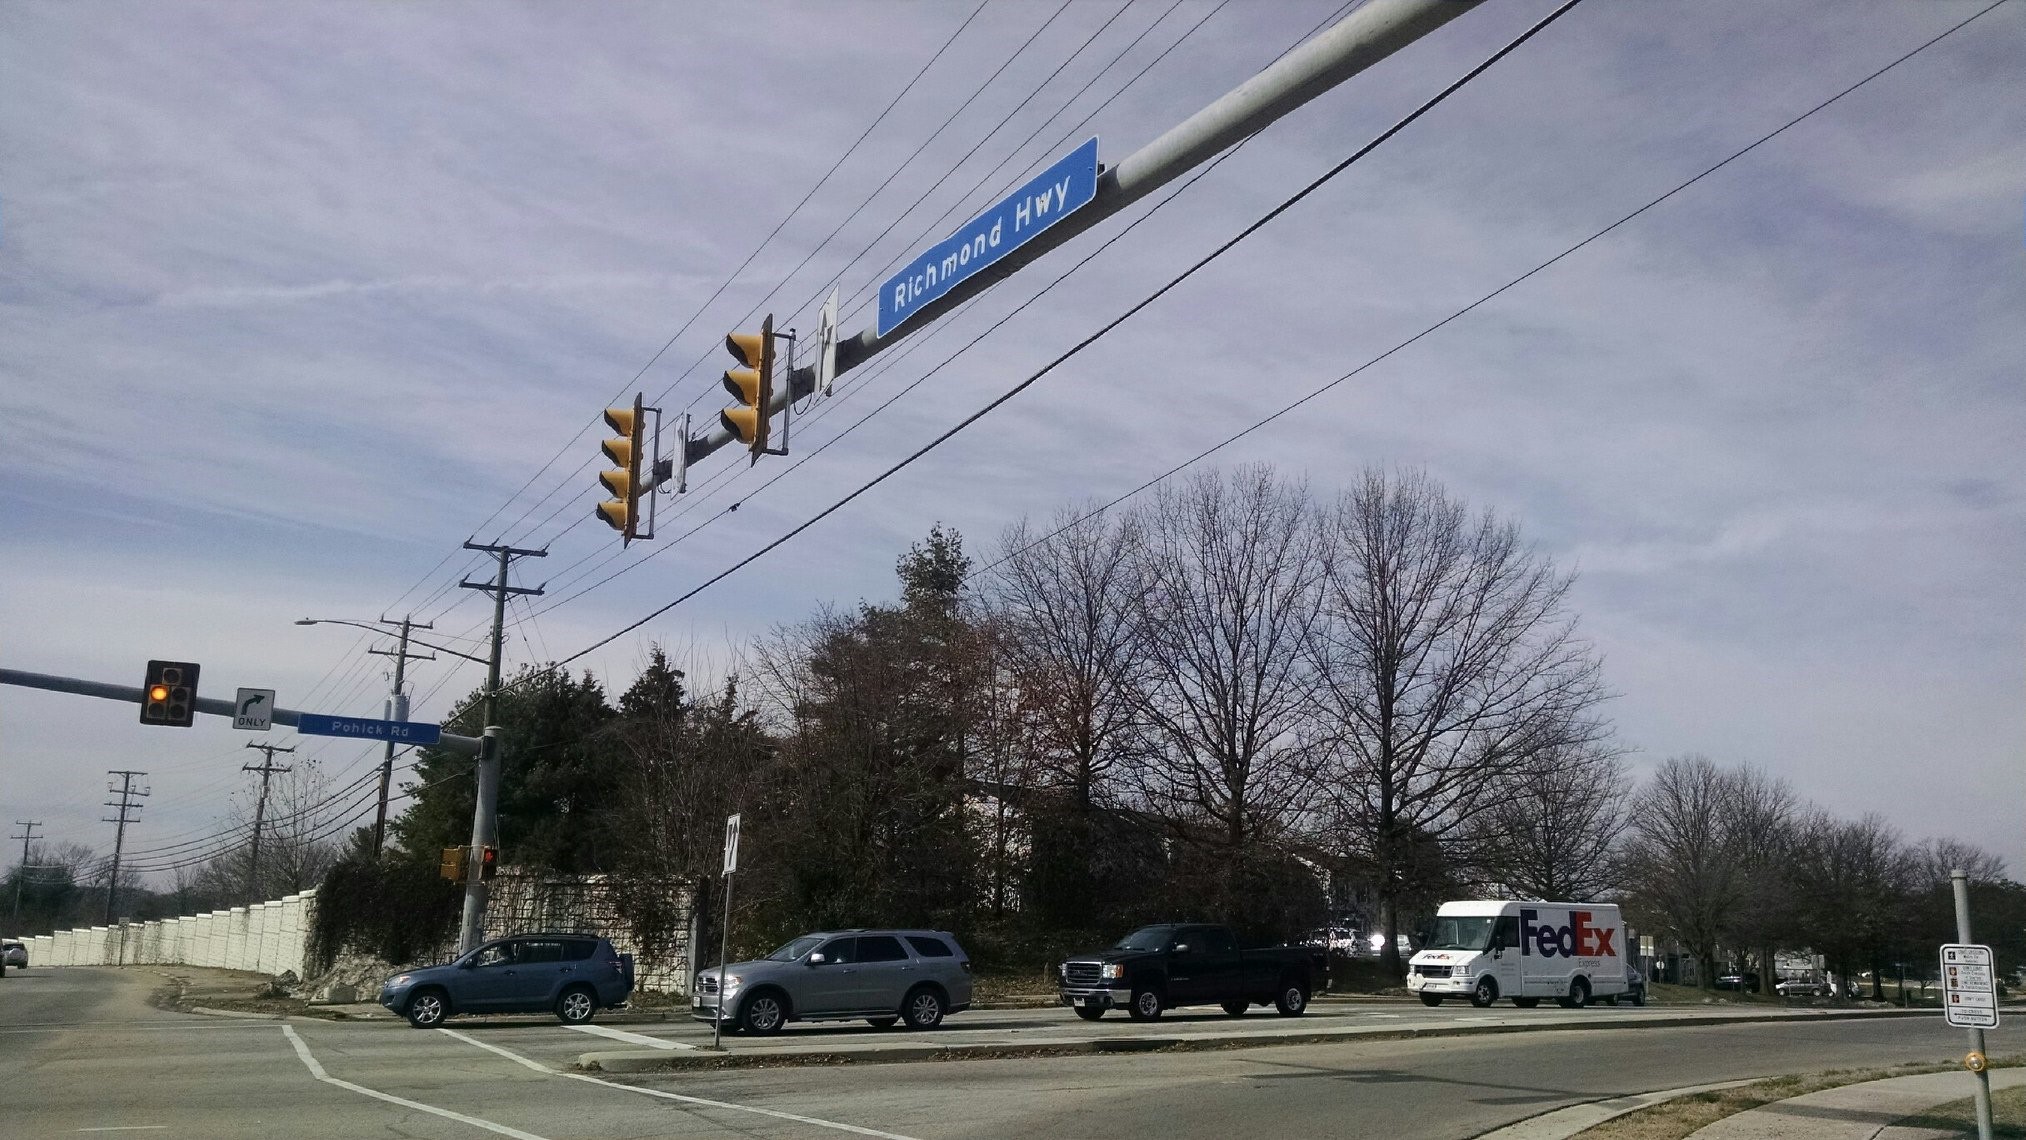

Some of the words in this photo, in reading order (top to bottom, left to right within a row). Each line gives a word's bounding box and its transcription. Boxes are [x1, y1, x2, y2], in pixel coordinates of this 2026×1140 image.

[894, 216, 1003, 313] Richmond
[1015, 175, 1071, 233] Hwy
[238, 717, 266, 727] ONLY
[331, 721, 383, 736] Pohick
[390, 725, 409, 737] Rd
[1520, 909, 1617, 958] FedEx
[1578, 958, 1601, 969] Express
